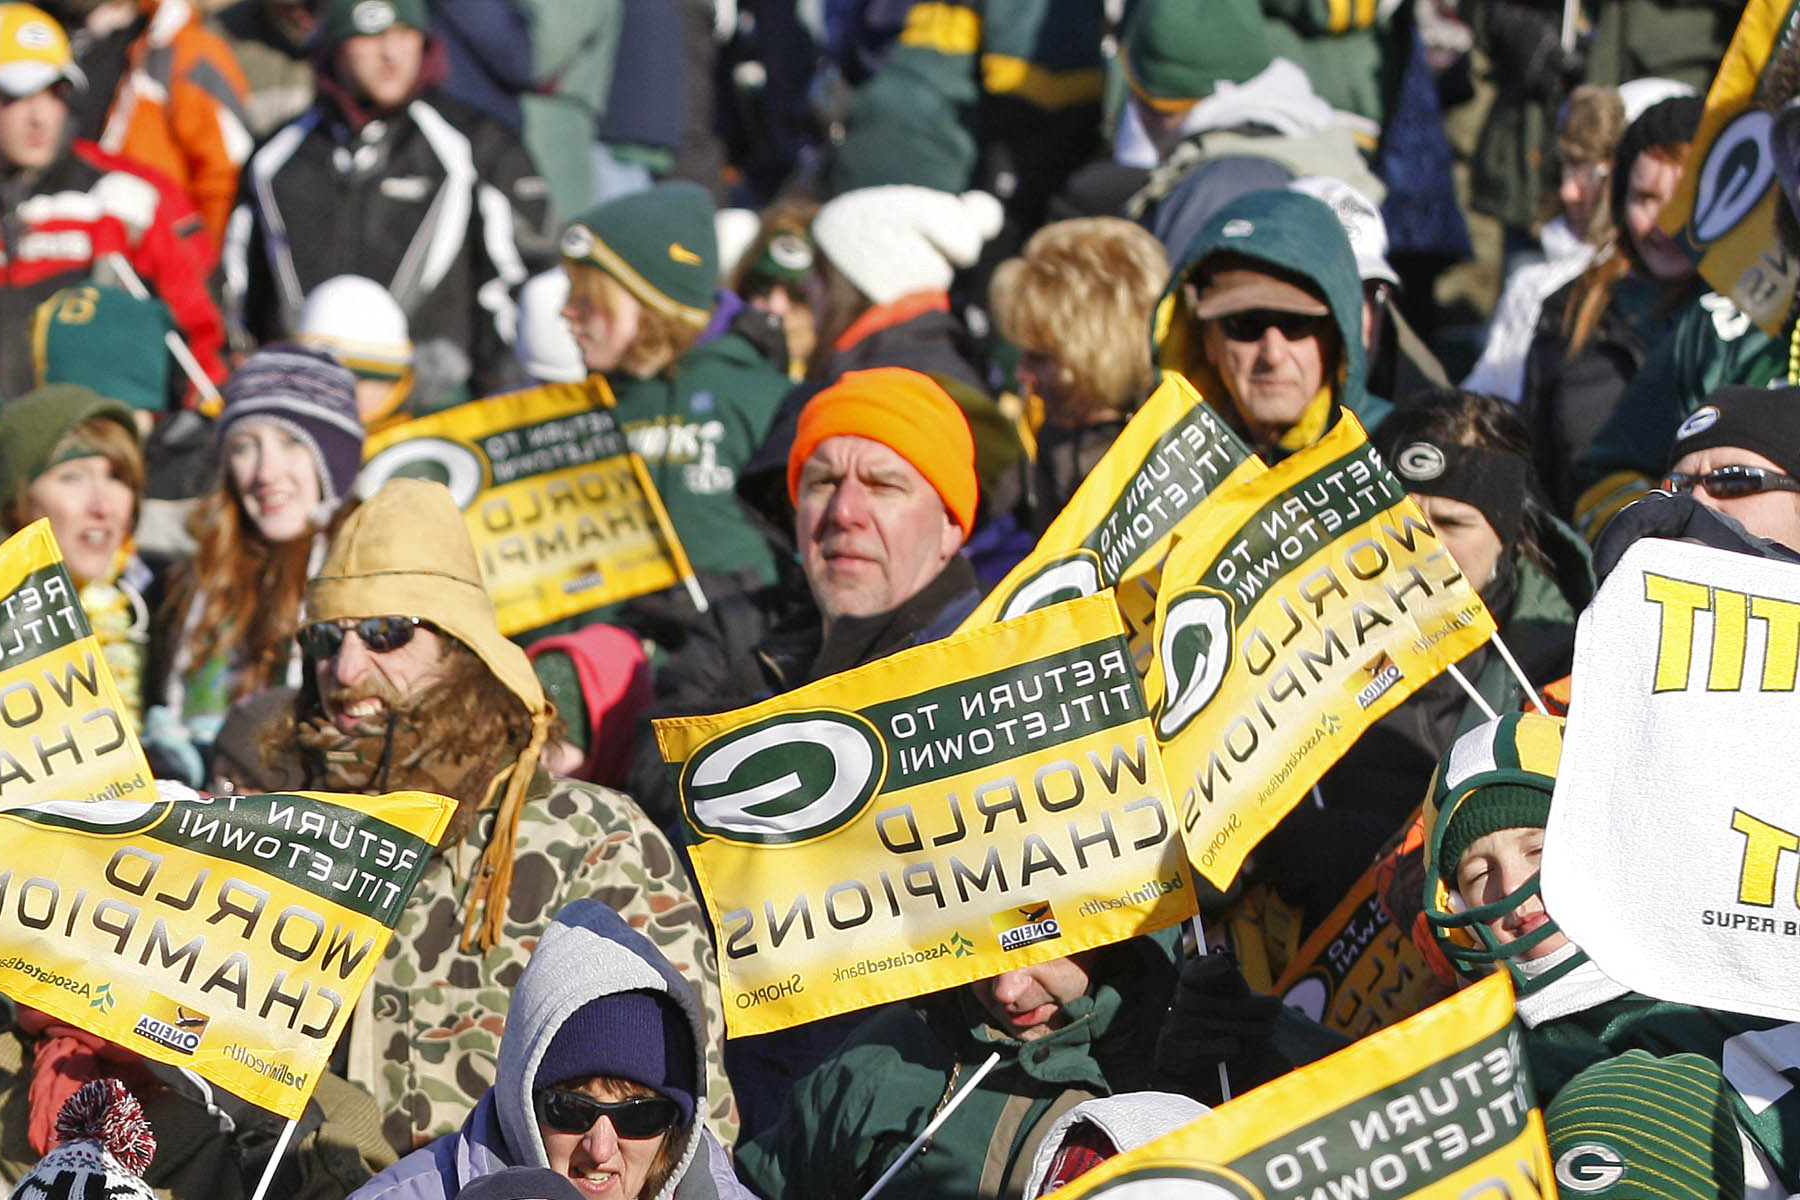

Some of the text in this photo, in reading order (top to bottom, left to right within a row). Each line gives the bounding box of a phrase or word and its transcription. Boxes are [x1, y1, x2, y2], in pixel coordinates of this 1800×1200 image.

[1642, 570, 1800, 694] TIT
[1729, 805, 1800, 909] T
[1701, 909, 1776, 937] SUPER
[1555, 1145, 1625, 1191] G
